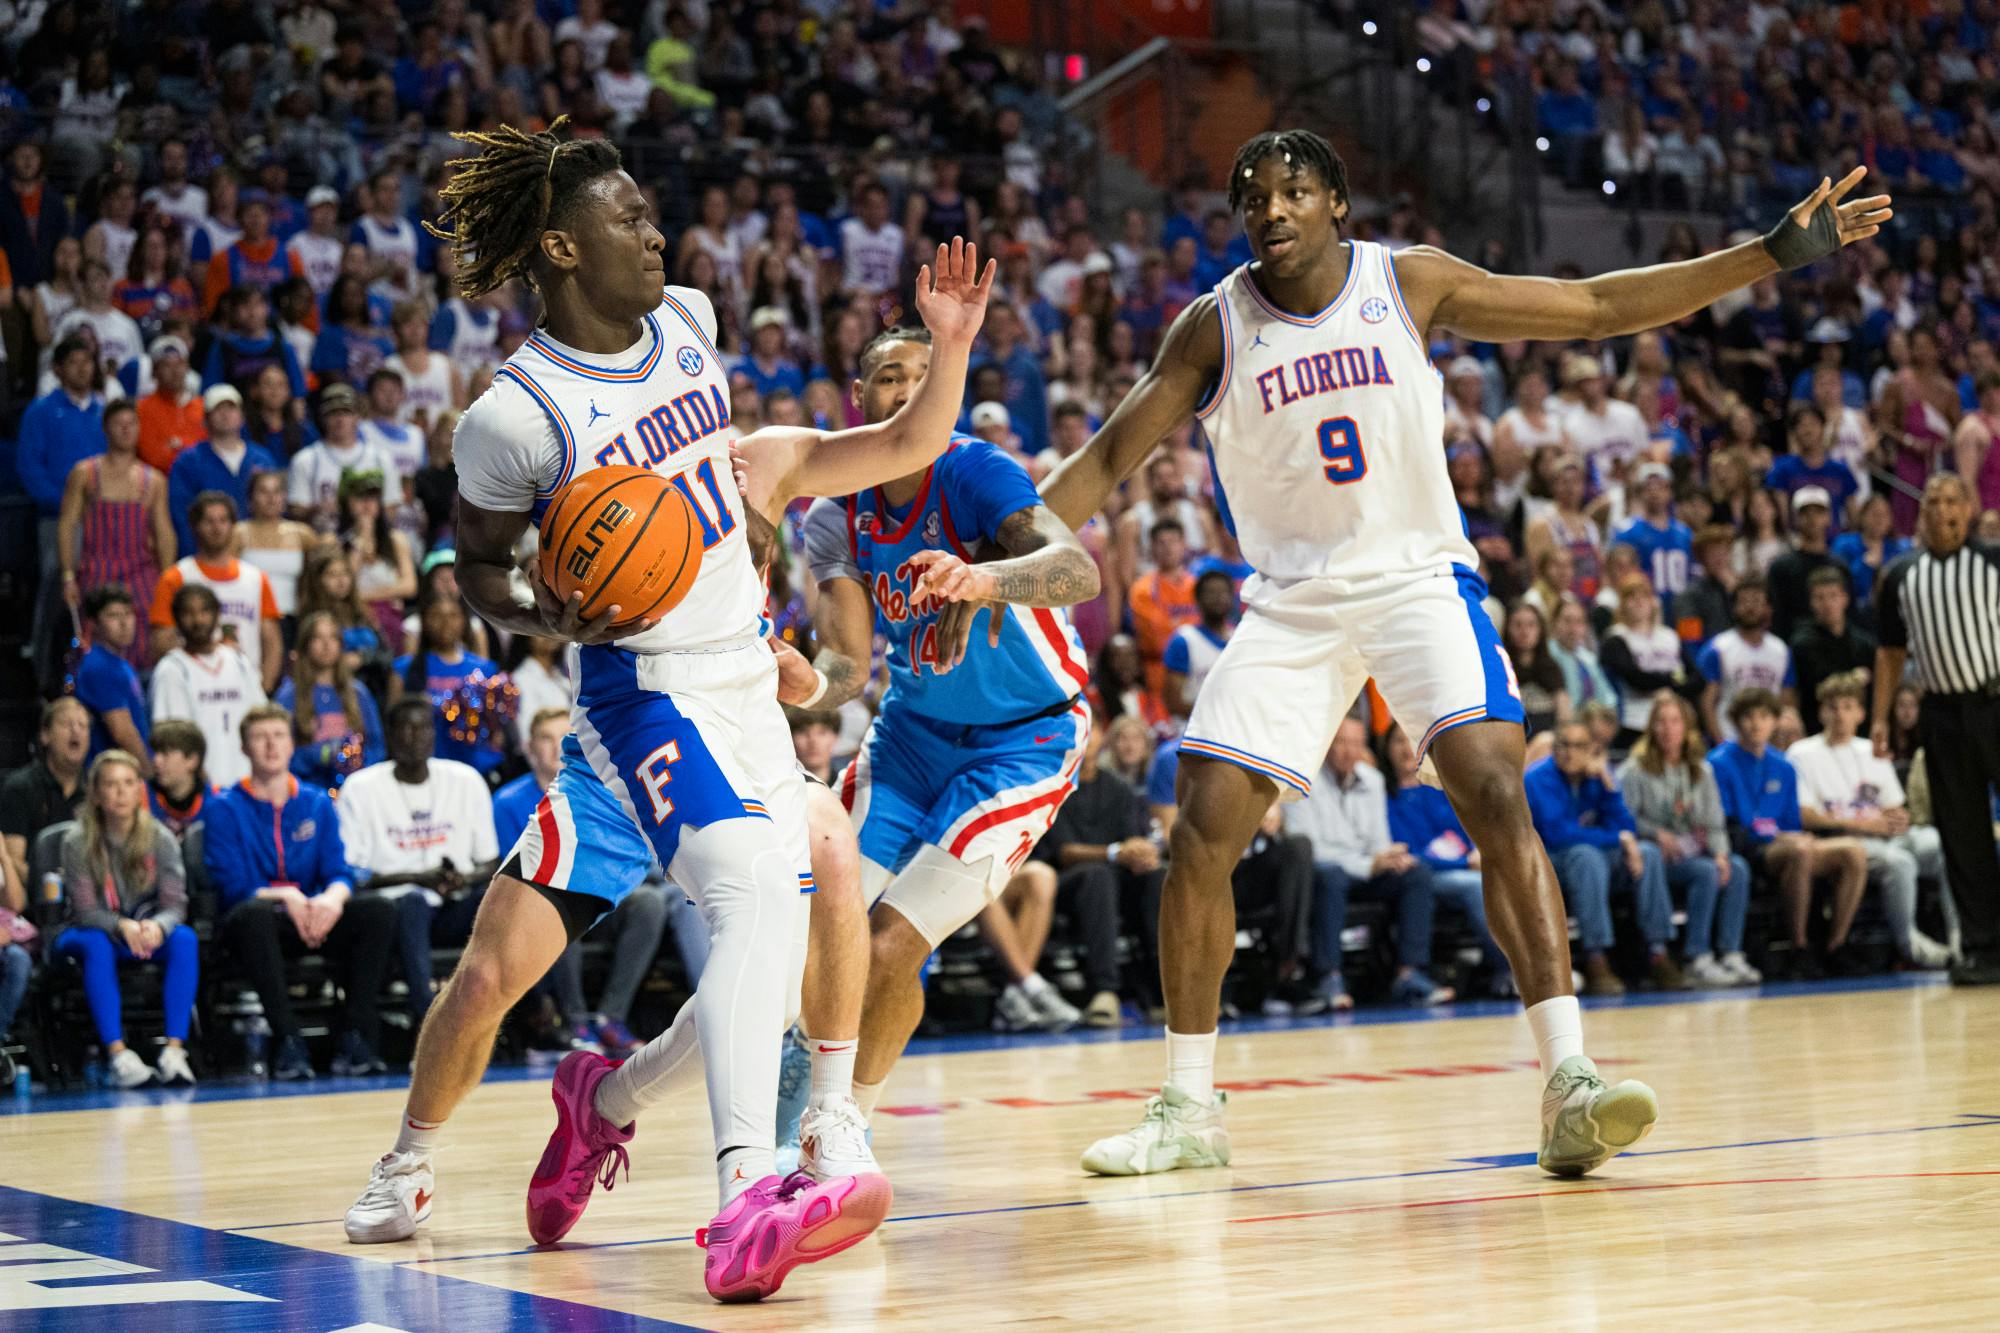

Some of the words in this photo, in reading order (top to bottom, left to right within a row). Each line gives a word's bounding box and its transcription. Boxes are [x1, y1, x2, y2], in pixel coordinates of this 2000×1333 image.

[1361, 298, 1388, 323] SEC
[677, 346, 703, 376] SEC
[1256, 346, 1394, 415] FLORIDA
[1316, 416, 1368, 485] 9
[669, 457, 736, 552] 11
[566, 499, 631, 580] ELITE
[1652, 549, 1689, 593] 10
[864, 572, 908, 623] le
[634, 738, 682, 827] F
